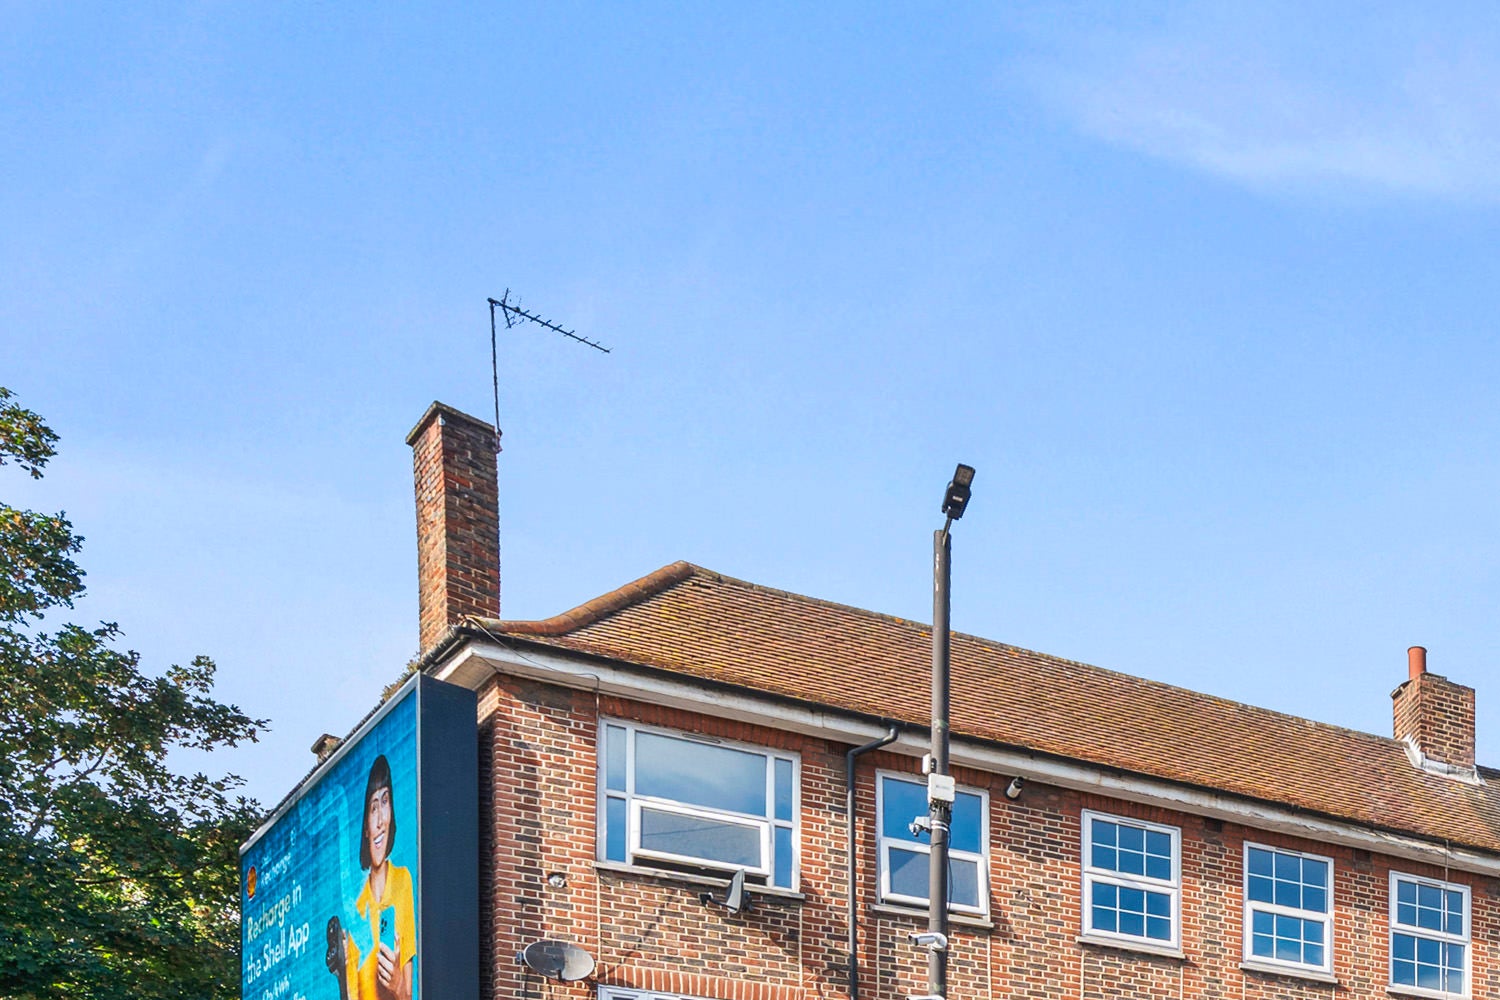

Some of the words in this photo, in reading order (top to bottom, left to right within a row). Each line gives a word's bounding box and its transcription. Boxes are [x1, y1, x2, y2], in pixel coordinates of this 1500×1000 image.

[247, 894, 291, 944] Recharge
[292, 879, 302, 909] in
[247, 954, 261, 984] the
[263, 928, 286, 973] Shell
[287, 921, 310, 958] App
